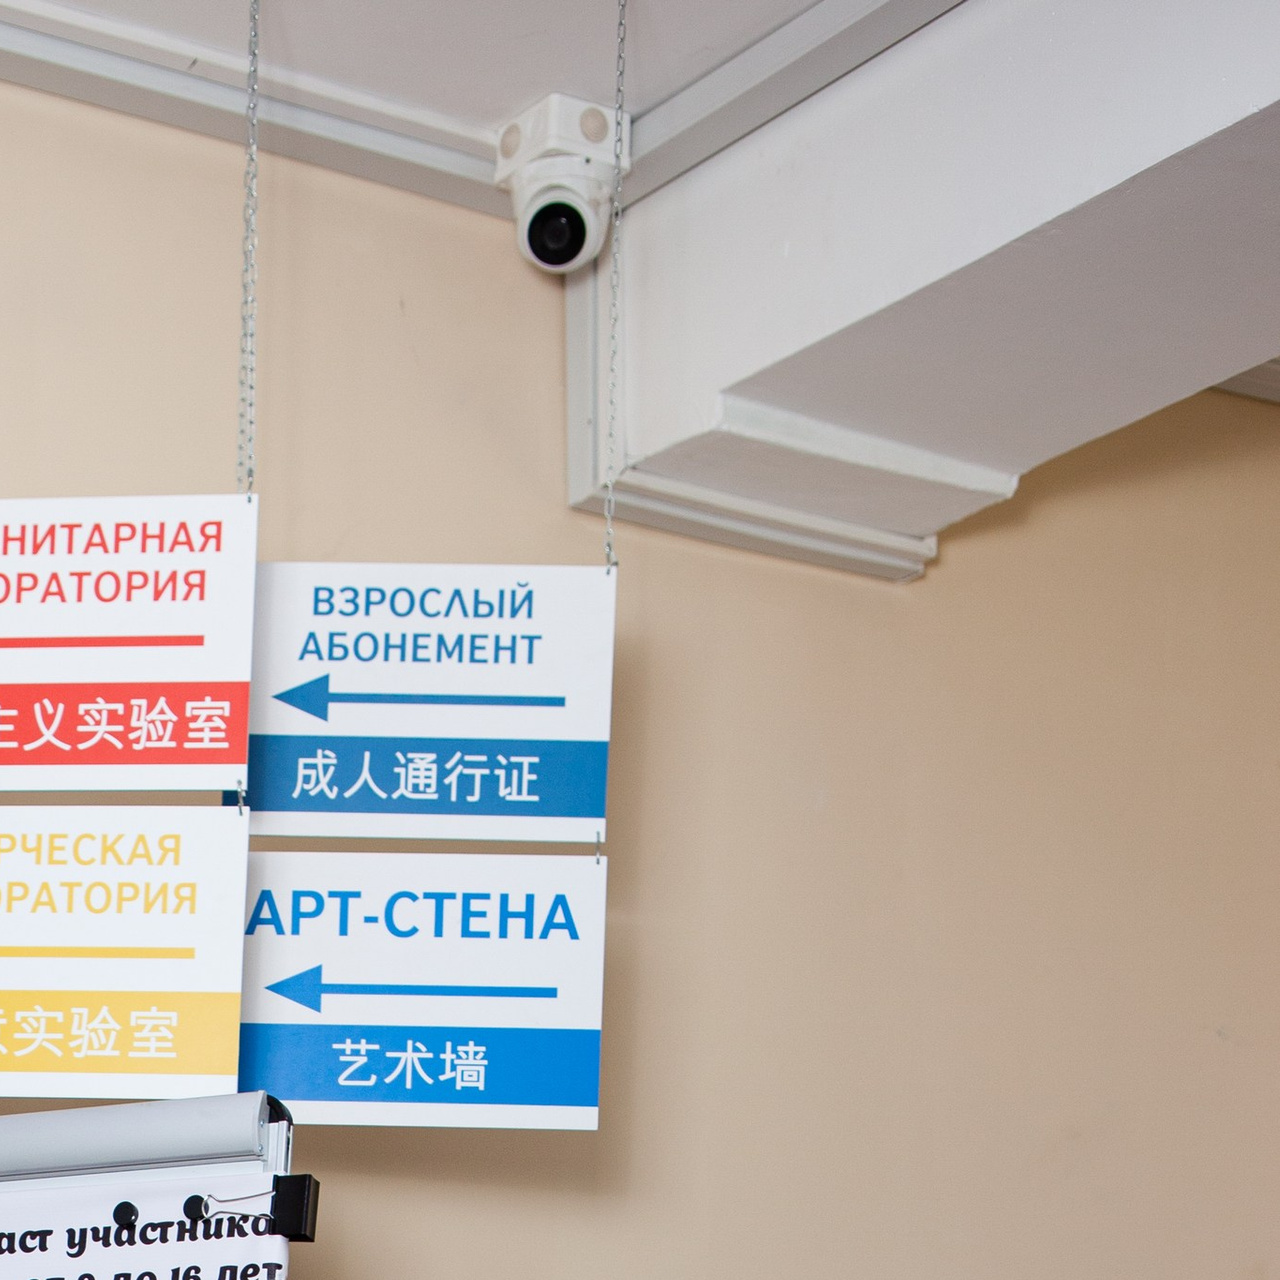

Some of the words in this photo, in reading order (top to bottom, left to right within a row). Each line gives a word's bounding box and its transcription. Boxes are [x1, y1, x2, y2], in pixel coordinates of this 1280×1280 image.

[312, 580, 535, 620] ВЗРОСЛЫЙ
[298, 631, 543, 665] АБОНЕМЕНТ
[291, 752, 540, 802] 成人通行证
[245, 889, 581, 941] АРТ-СТЕНА
[331, 1038, 489, 1091] 艺术墙
[66, 1213, 273, 1258] участнико
